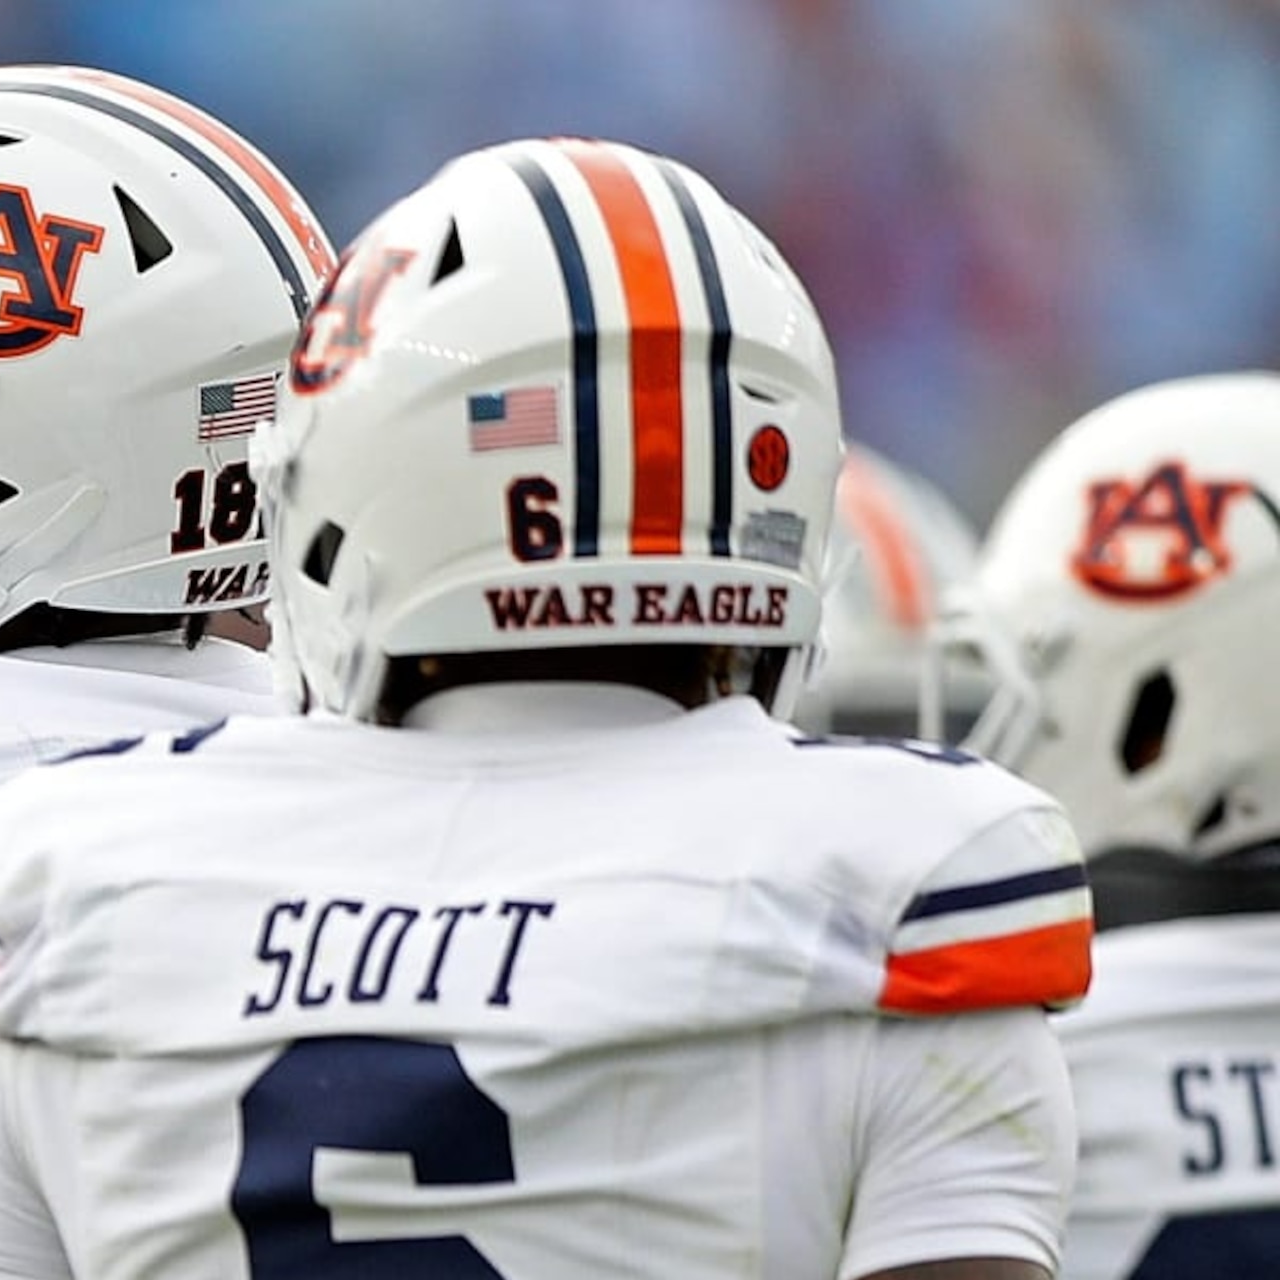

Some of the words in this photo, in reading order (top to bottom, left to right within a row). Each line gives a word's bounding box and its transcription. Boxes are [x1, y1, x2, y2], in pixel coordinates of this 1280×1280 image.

[170, 461, 258, 554] 18
[505, 476, 562, 562] 6
[483, 586, 615, 631] WAR
[632, 585, 788, 628] EAGLE
[242, 900, 555, 1017] SCOTT
